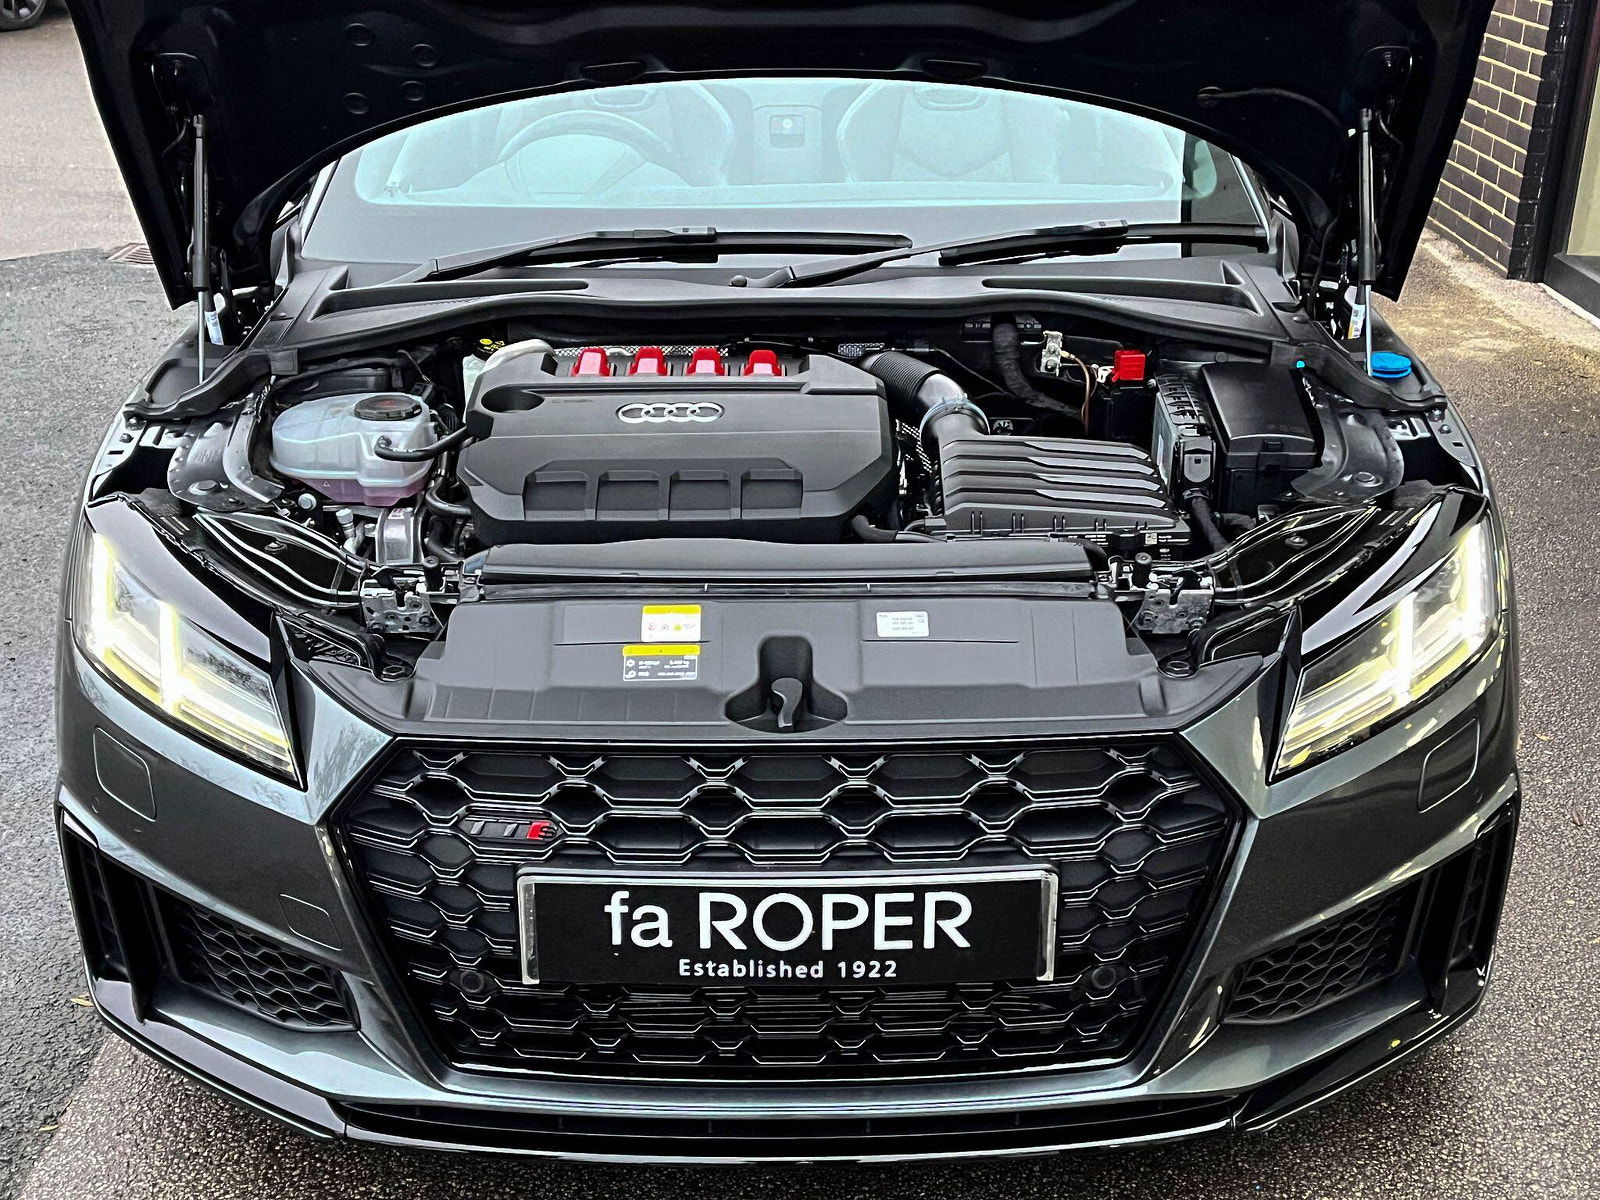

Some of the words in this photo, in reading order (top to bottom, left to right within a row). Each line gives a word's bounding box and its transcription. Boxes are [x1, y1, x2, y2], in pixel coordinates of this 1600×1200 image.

[604, 890, 673, 948] fa
[698, 890, 973, 952] ROPER
[678, 958, 824, 979] Established
[837, 960, 898, 979] 1922
